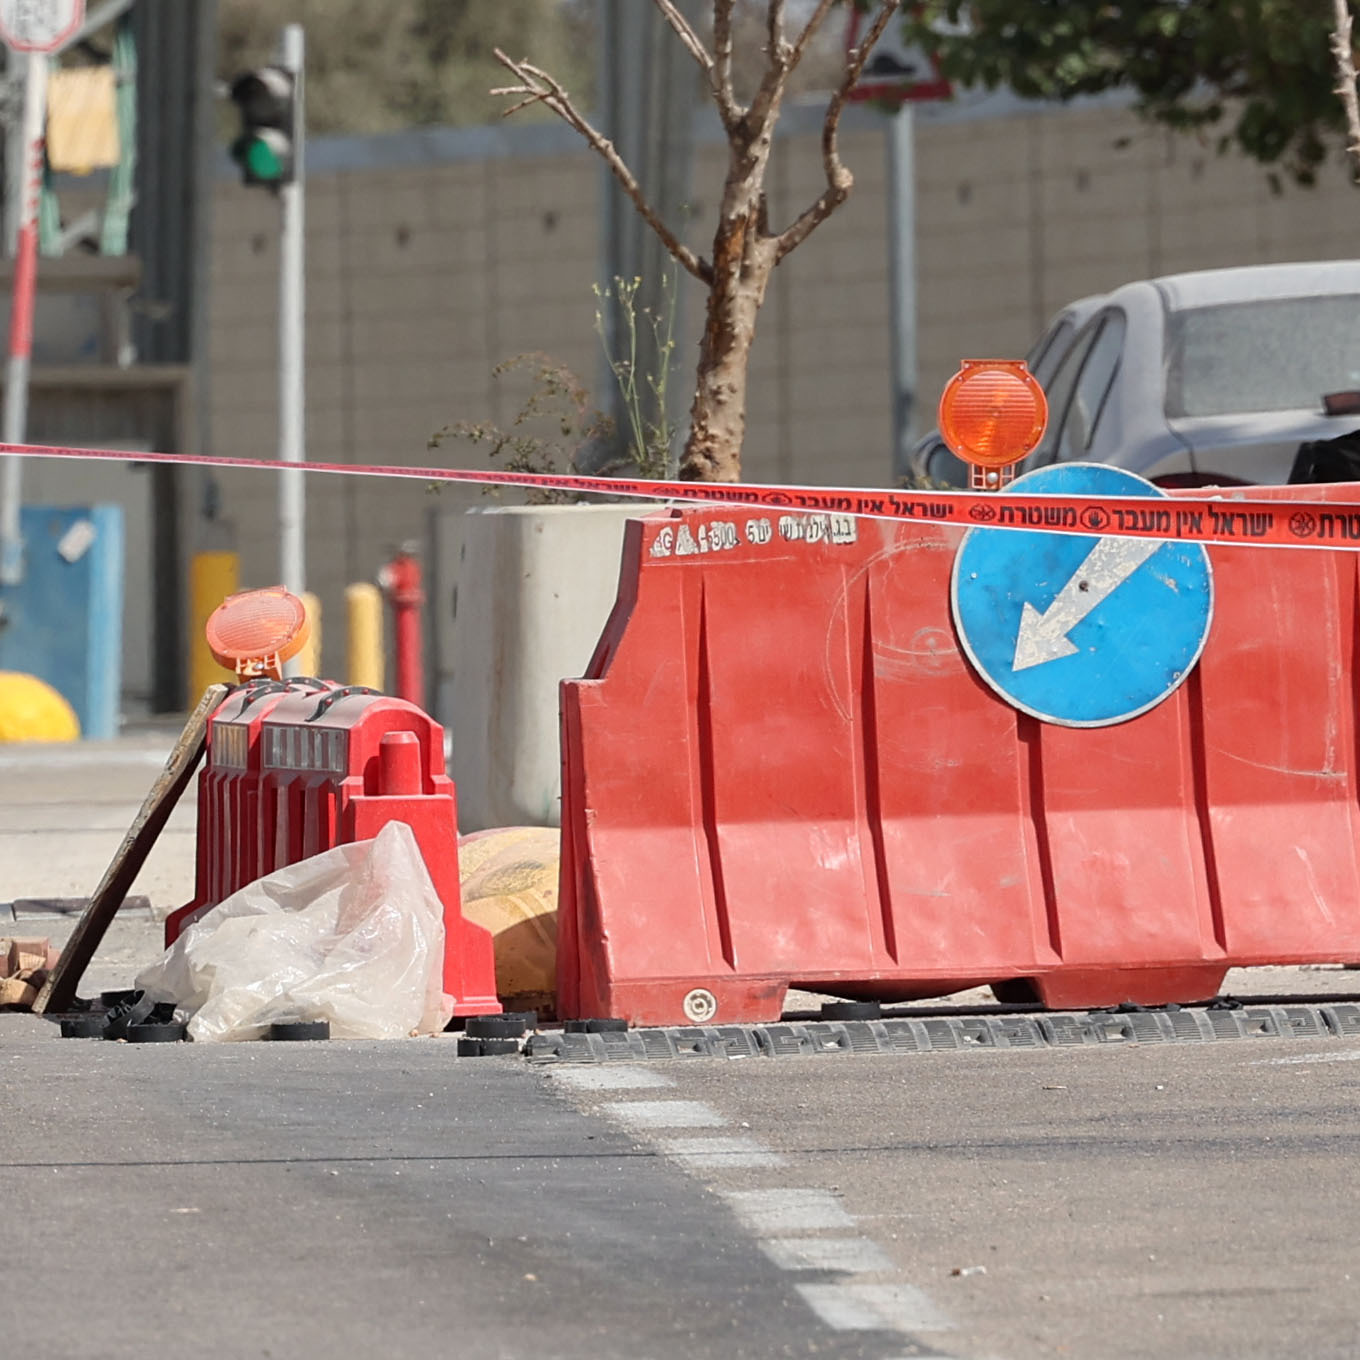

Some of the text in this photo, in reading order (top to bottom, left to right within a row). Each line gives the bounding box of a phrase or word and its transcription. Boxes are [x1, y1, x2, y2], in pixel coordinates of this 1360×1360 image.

[793, 496, 852, 511] מעבר
[855, 498, 884, 515] אין
[888, 495, 953, 519] ישראל
[997, 504, 1274, 536] משטרת ישראל אין מעבר
